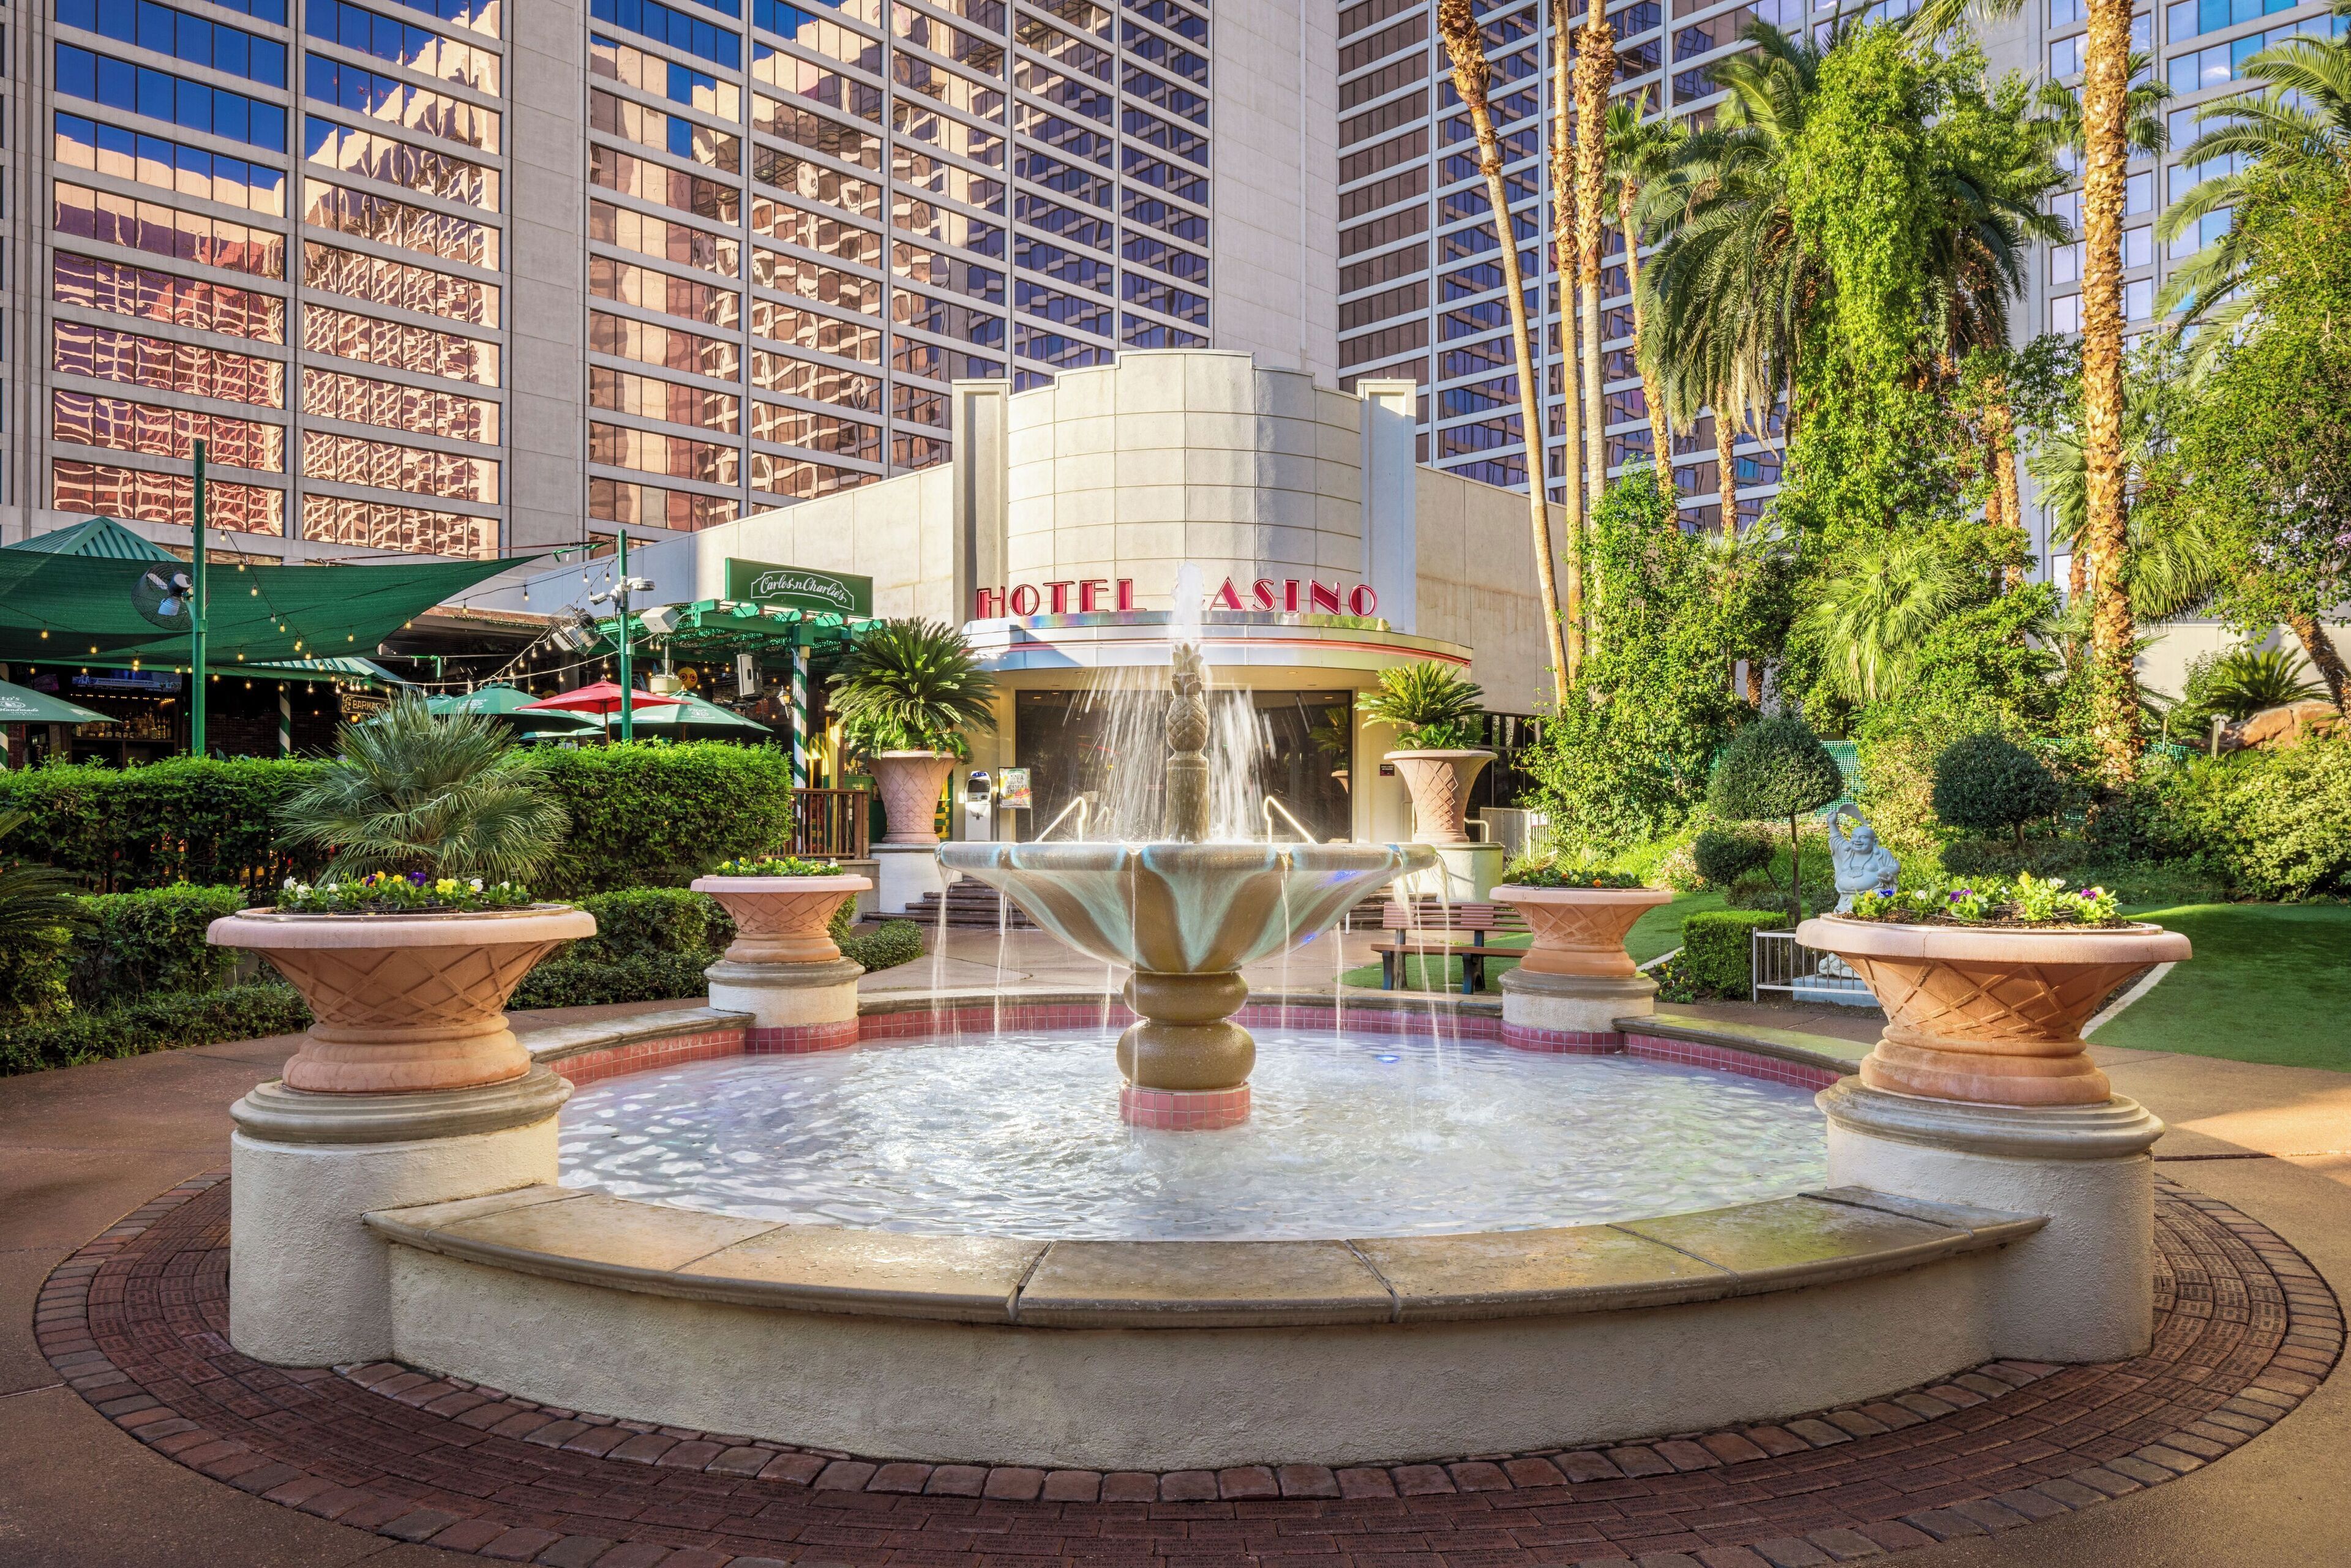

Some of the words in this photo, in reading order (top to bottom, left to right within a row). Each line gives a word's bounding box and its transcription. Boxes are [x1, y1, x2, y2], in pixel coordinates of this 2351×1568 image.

[803, 577, 847, 603] Charlie's
[977, 579, 1147, 620] HOTEL
[1174, 576, 1377, 617] ASINO
